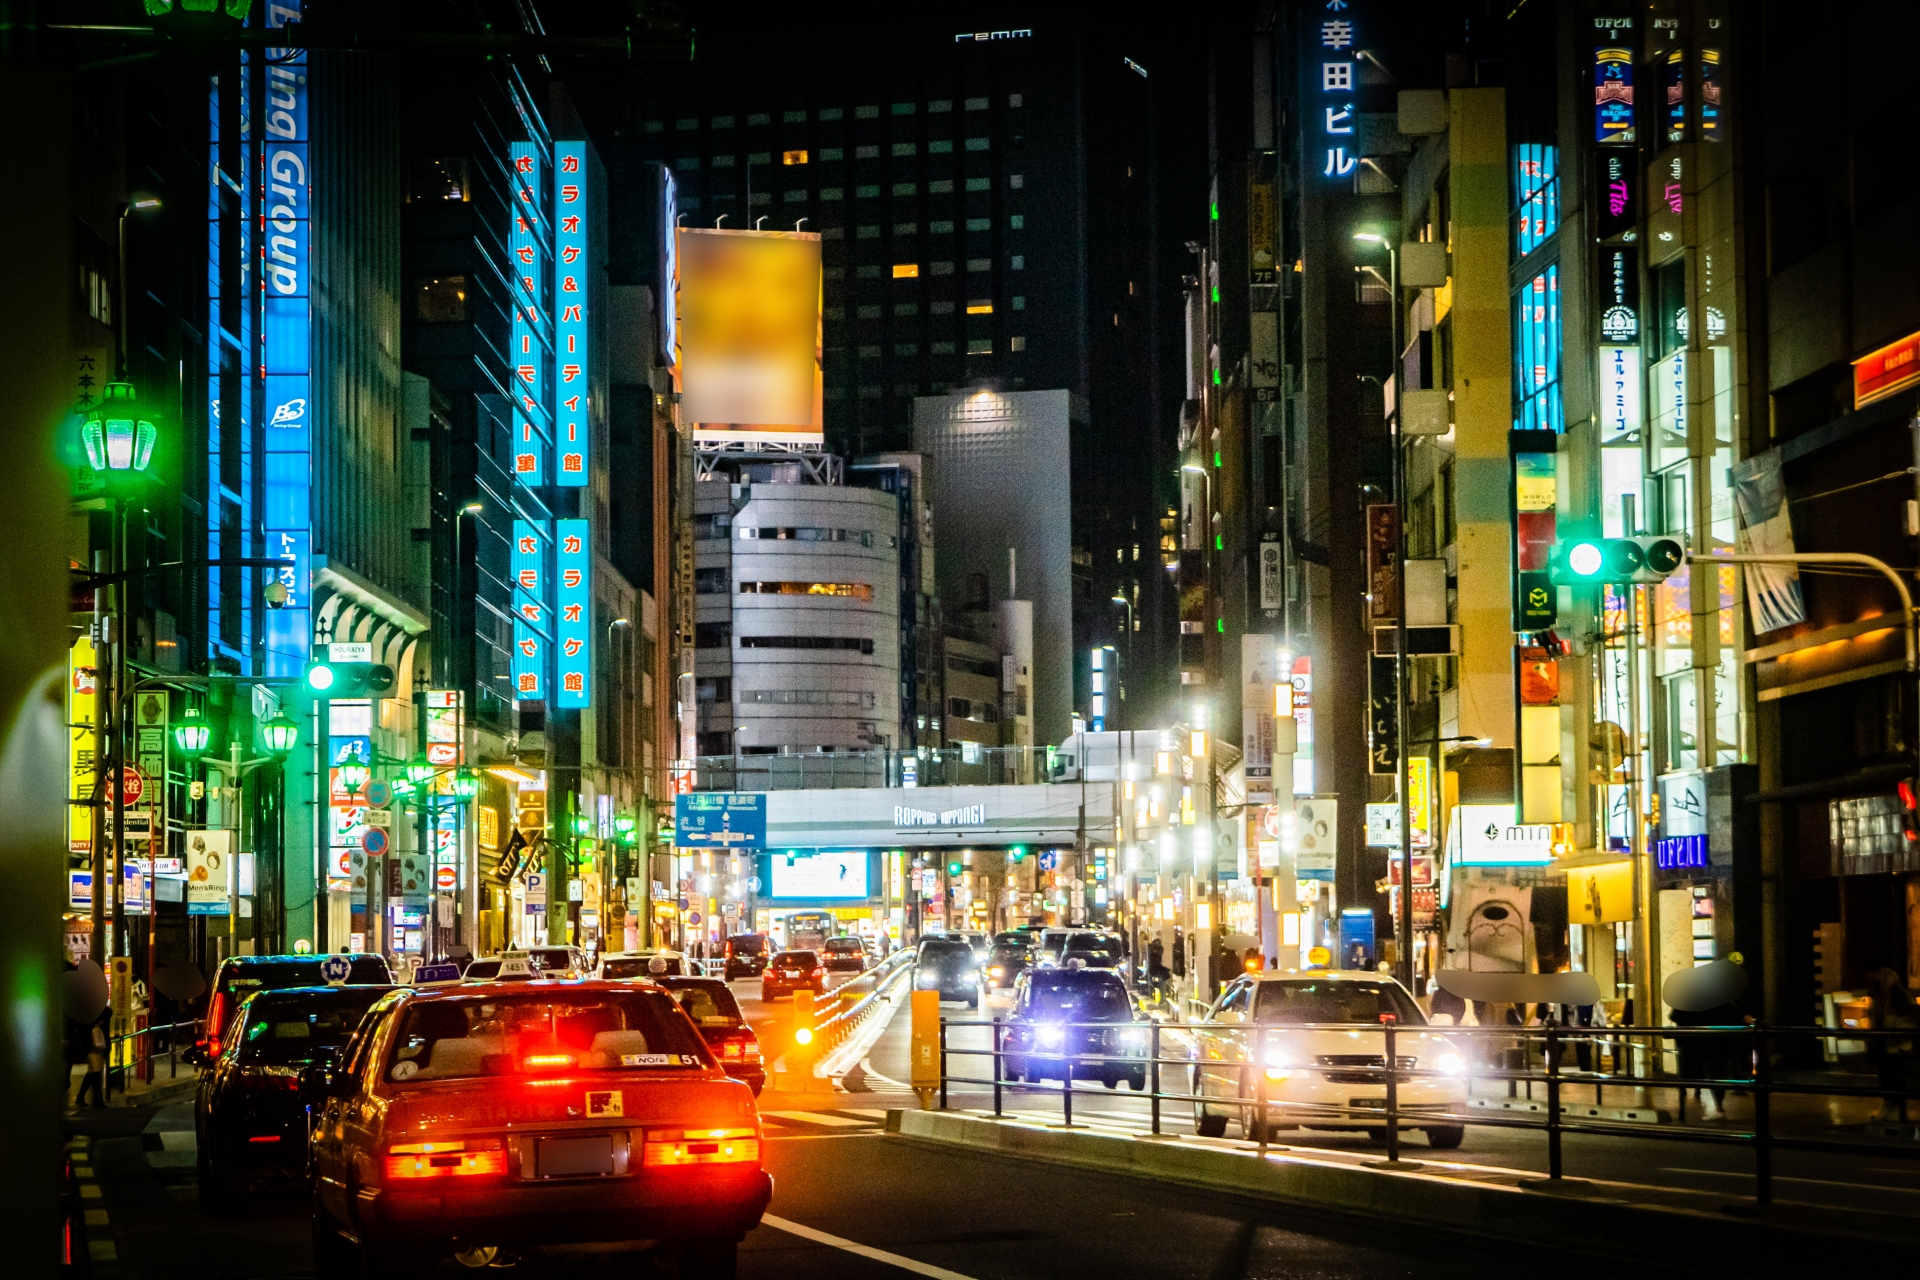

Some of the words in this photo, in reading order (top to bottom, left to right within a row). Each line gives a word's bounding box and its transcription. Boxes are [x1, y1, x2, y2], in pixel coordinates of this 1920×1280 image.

[955, 29, 1032, 42] remm
[1608, 157, 1622, 180] club
[265, 149, 305, 295] Group
[1254, 271, 1273, 282] 7F
[561, 154, 583, 473] カラオケ&パーティー館
[1626, 433, 1639, 442] 4F
[562, 536, 583, 692] カラオケ館
[1253, 768, 1267, 776] 4F
[894, 805, 937, 826] ROPPONGI
[940, 803, 985, 825] ROPPONGI
[529, 875, 541, 891] P
[330, 963, 343, 975] N
[506, 963, 525, 971] 1451
[681, 1054, 701, 1065] 51
